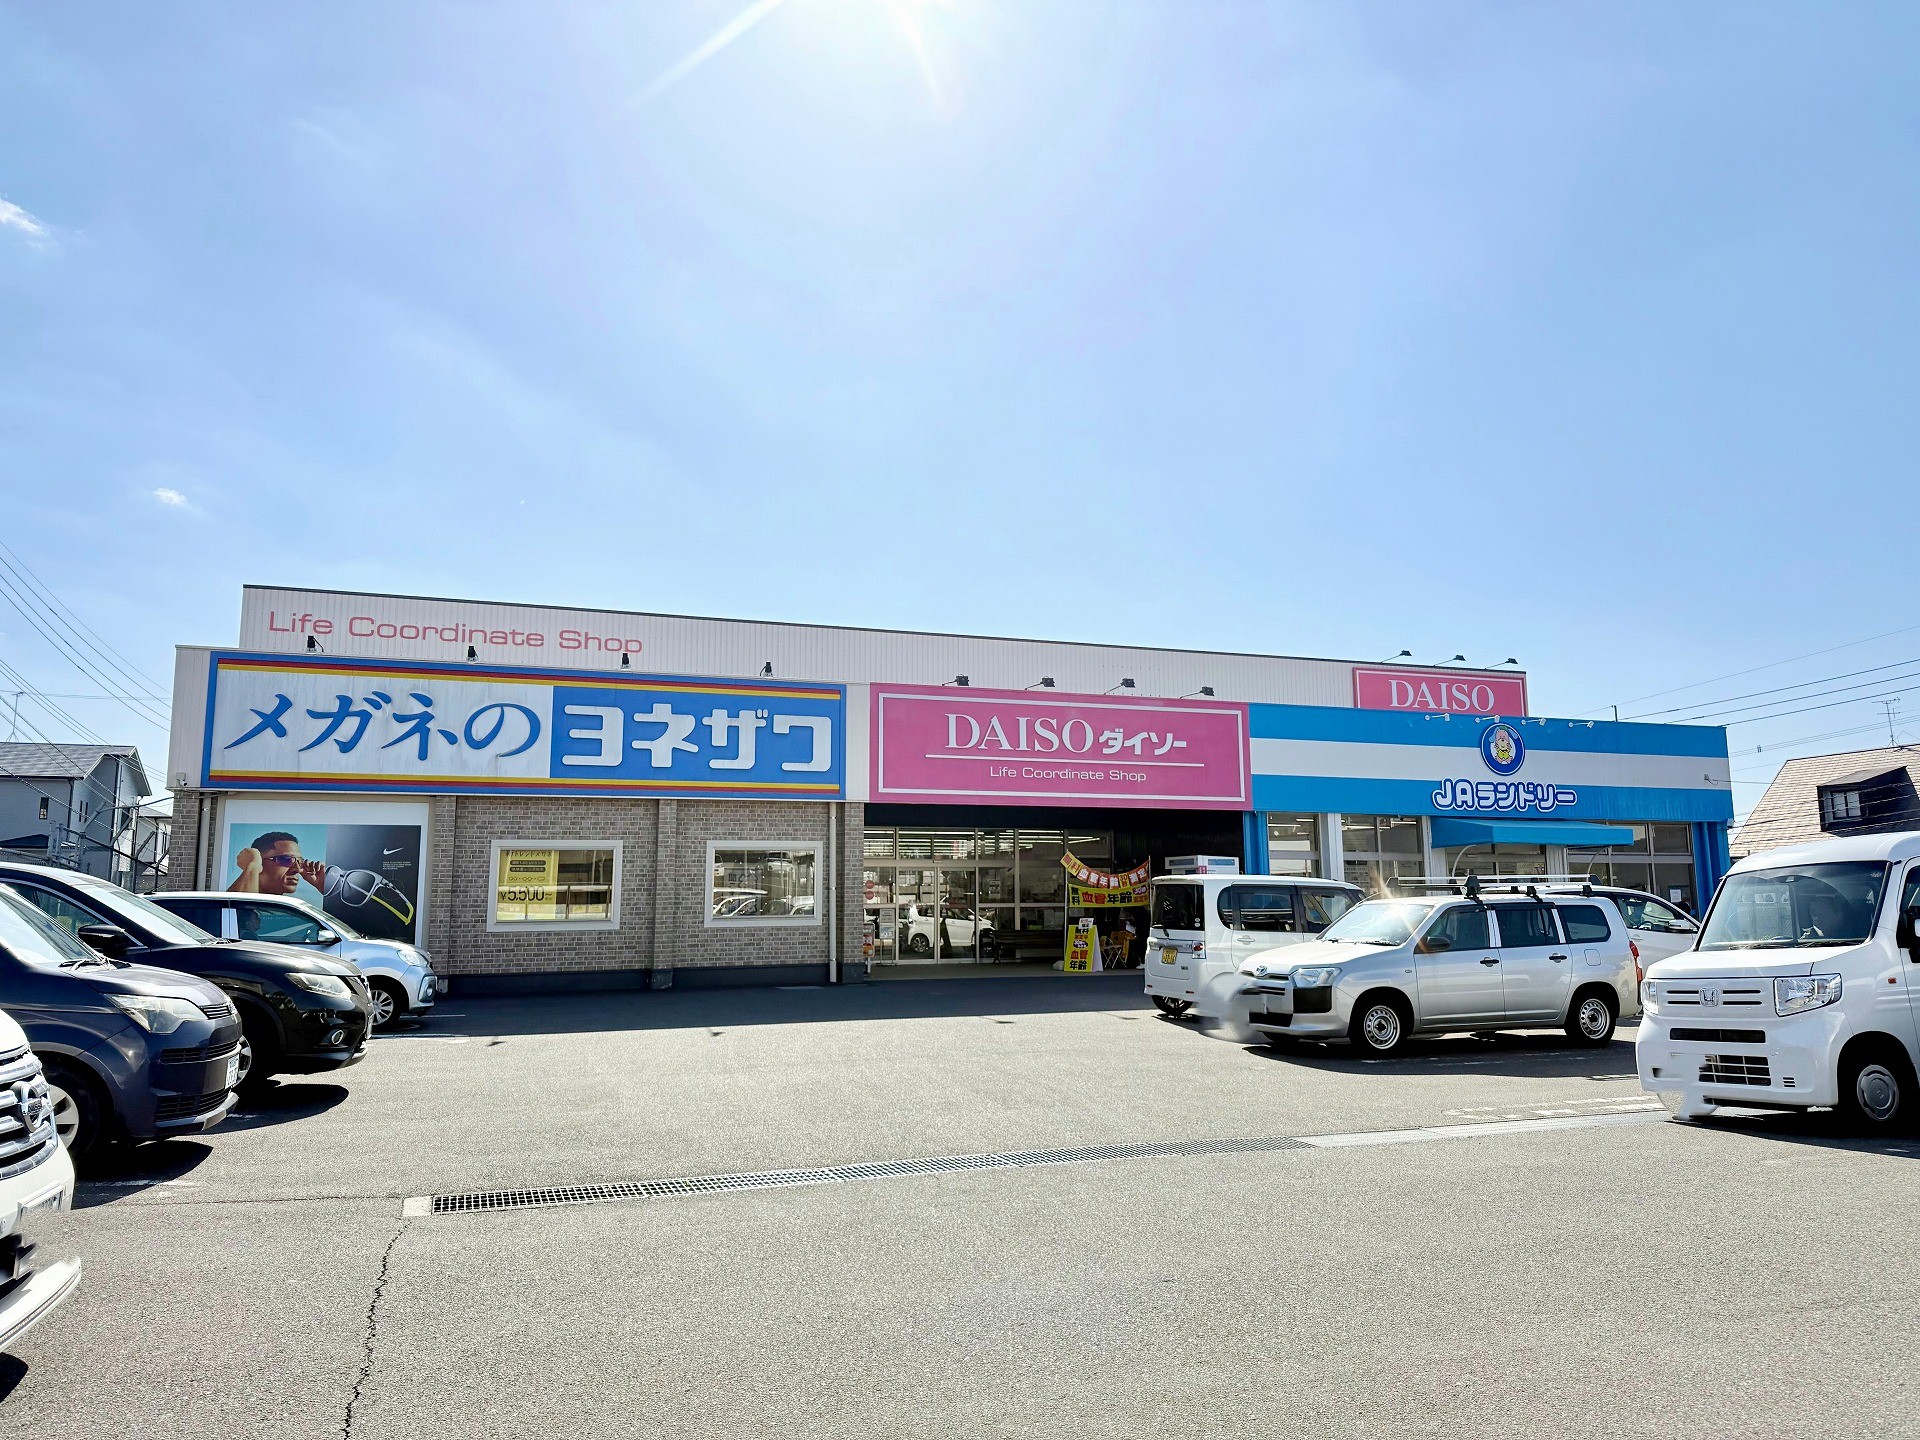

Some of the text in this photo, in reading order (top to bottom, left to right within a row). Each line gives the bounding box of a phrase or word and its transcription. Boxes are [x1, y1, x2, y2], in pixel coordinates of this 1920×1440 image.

[269, 611, 643, 654] Life Coordinate Shop
[1388, 679, 1495, 712] DAISO
[223, 690, 832, 773] メガネの ヨネザワ
[944, 713, 1187, 756] DAISO ダイソー
[990, 765, 1147, 783] Life Coordinate Shop
[1433, 778, 1577, 812] JAランドリー
